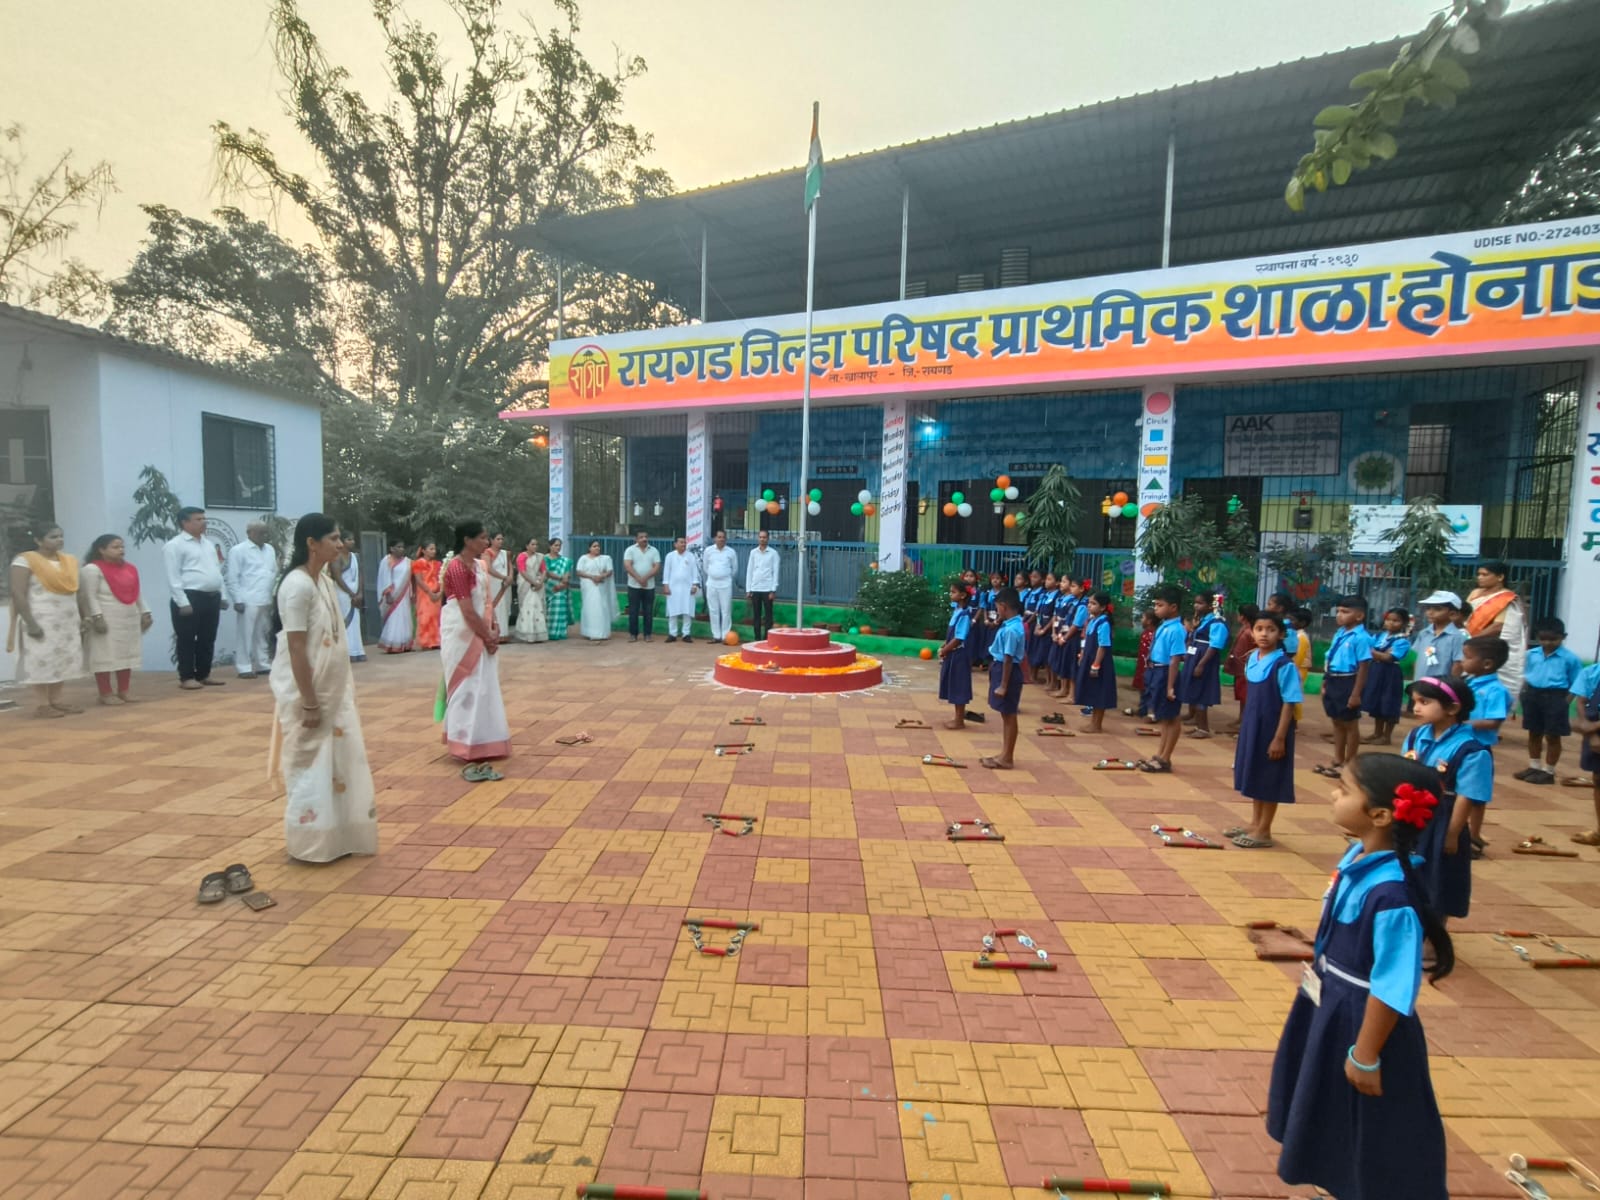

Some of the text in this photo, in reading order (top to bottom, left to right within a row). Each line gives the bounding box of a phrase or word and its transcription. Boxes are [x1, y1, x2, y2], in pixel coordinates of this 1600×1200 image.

[1473, 233, 1513, 249] UDISE
[616, 341, 737, 389] रायगड
[739, 328, 847, 378] जिल्हा
[851, 313, 982, 367] परिषद
[988, 288, 1214, 360] प्राथमिक
[1146, 417, 1169, 425] Circle
[1230, 414, 1275, 433] AAK
[883, 427, 905, 443] Monday
[1143, 444, 1169, 452] Square
[881, 487, 900, 503] Friday
